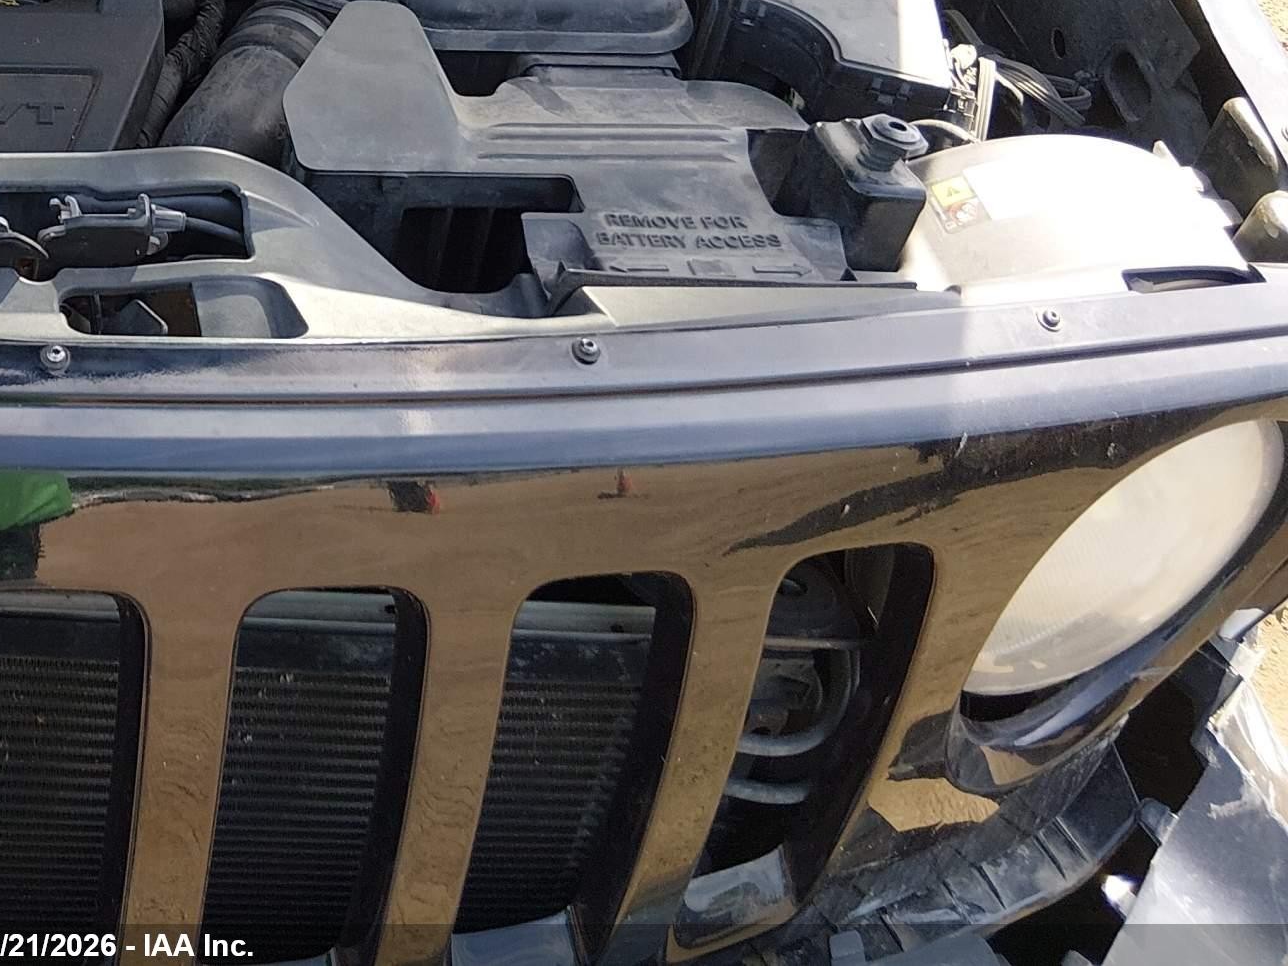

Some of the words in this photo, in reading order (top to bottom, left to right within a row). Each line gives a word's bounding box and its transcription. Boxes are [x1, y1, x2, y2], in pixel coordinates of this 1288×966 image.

[604, 213, 697, 230] REMOVE
[701, 215, 748, 230] FOR
[596, 231, 687, 249] BATTERY
[695, 233, 782, 250] ACCESS
